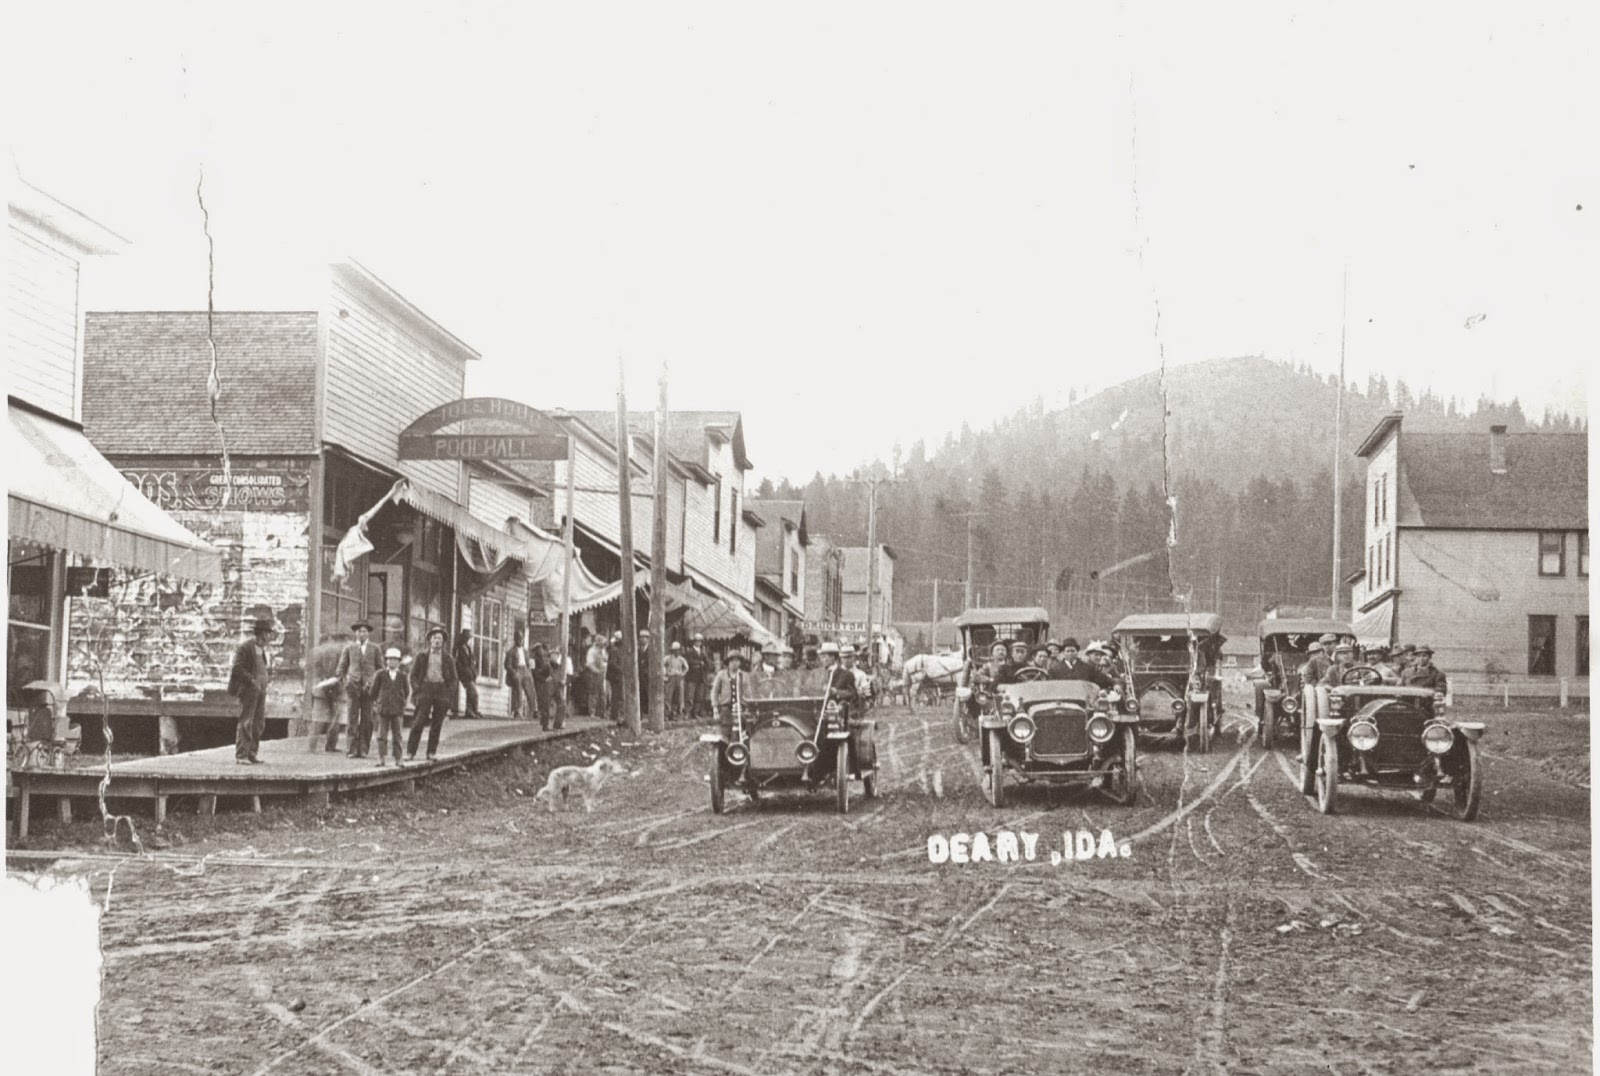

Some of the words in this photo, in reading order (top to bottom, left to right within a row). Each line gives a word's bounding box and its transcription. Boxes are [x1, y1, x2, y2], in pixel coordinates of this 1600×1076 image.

[210, 475, 232, 485] GREAT
[233, 475, 282, 486] CONSOLIDATED
[204, 486, 286, 506] SHOWS
